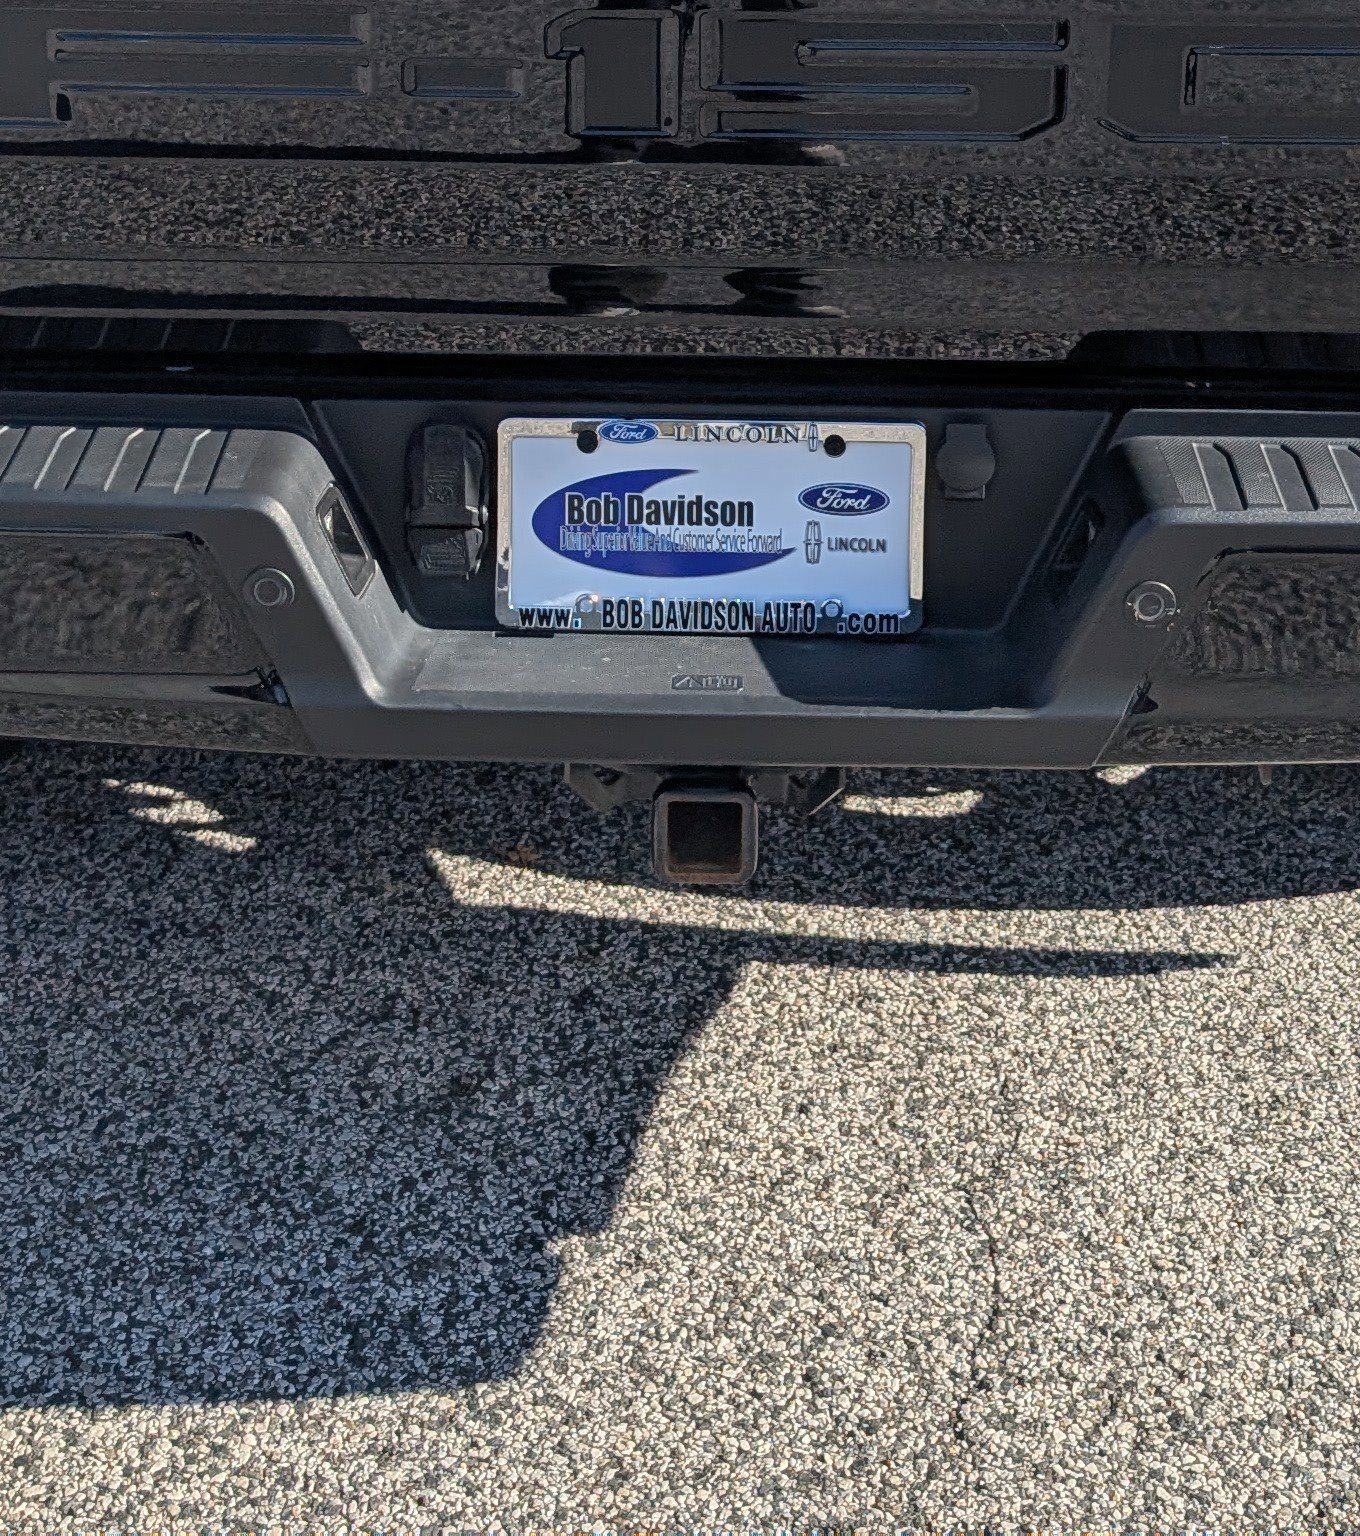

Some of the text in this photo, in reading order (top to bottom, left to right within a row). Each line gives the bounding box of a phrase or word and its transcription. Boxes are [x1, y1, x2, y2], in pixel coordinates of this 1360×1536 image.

[609, 424, 801, 443] Ford LINCOLN
[565, 492, 754, 527] Bob Davidson
[816, 486, 871, 511] Ford
[673, 527, 715, 553] Customer
[716, 528, 746, 553] Service
[747, 528, 782, 553] Forward
[827, 536, 886, 553] LINCOLN
[601, 600, 644, 629] BOB
[651, 600, 755, 632] DAVIDSON
[761, 601, 816, 633] AUTO
